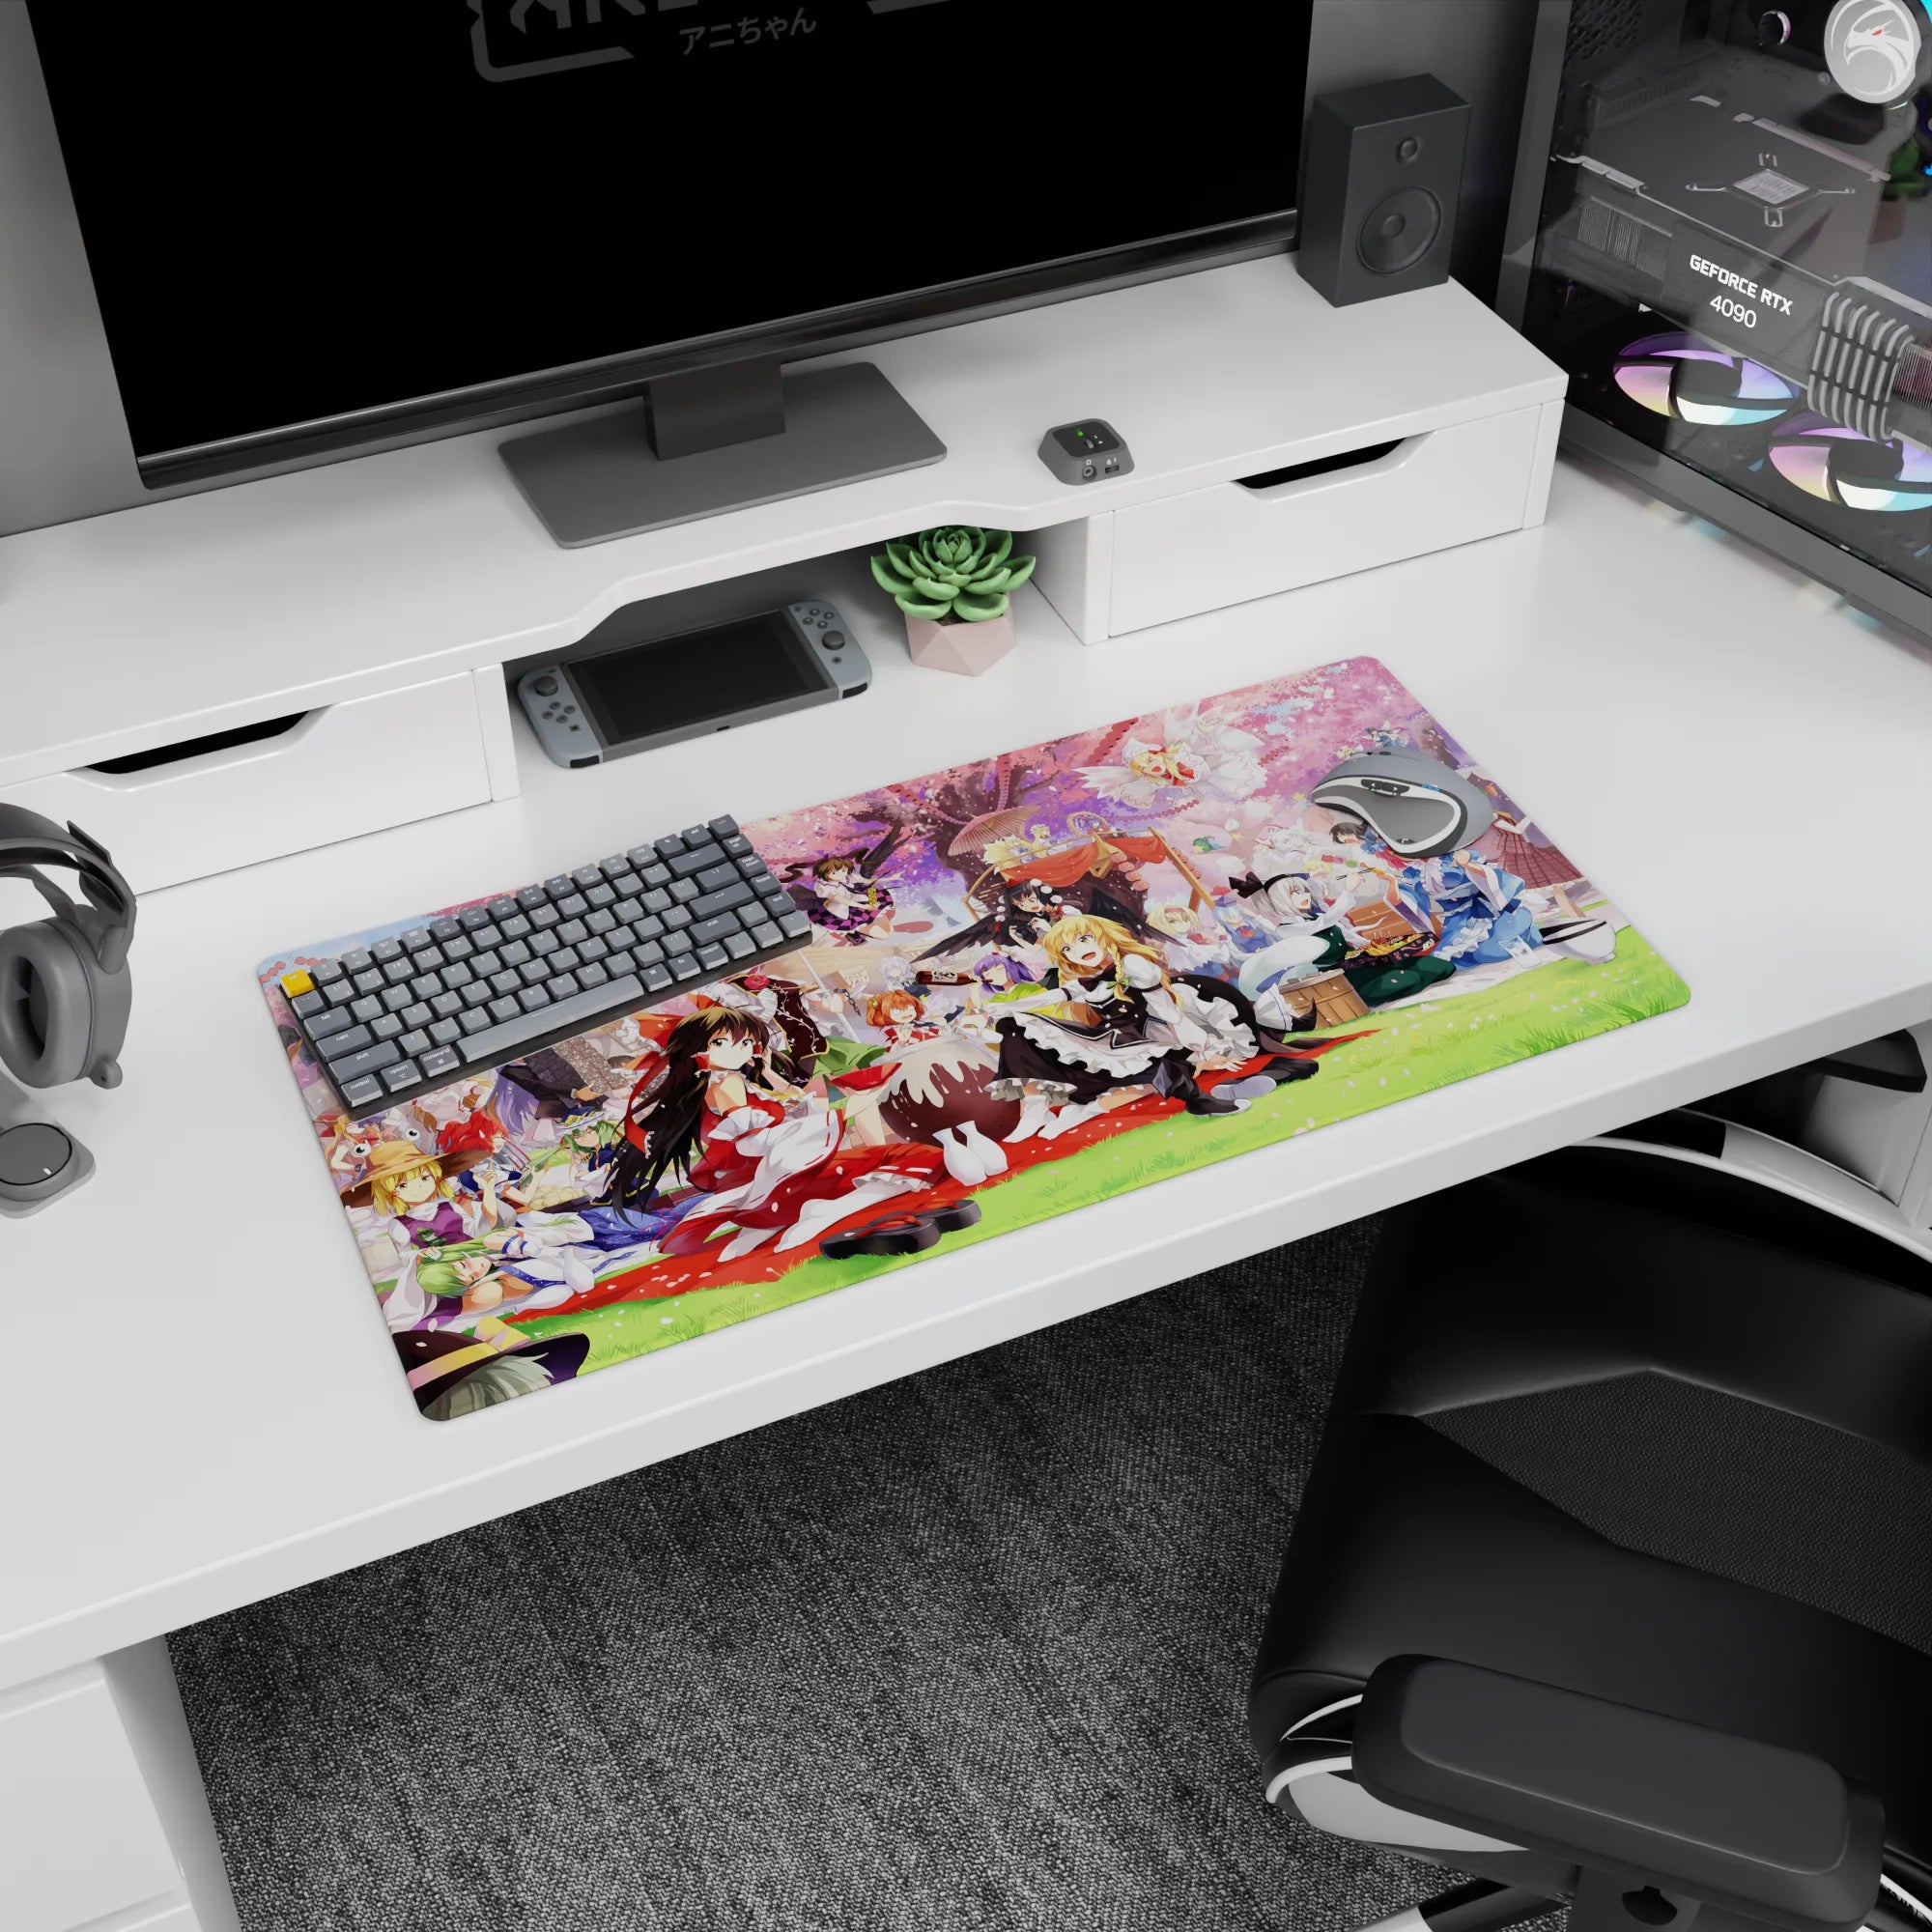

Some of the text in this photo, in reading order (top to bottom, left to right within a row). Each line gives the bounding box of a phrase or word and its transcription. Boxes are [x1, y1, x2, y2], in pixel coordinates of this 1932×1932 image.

[679, 7, 816, 55] アニちゃん
[1690, 254, 1793, 315] GEFORCE RTX
[1710, 295, 1757, 328] 4090
[700, 945, 719, 954] control
[355, 1052, 369, 1061] shift
[423, 1048, 450, 1061] command
[389, 1065, 408, 1075] option
[350, 1078, 370, 1090] control
